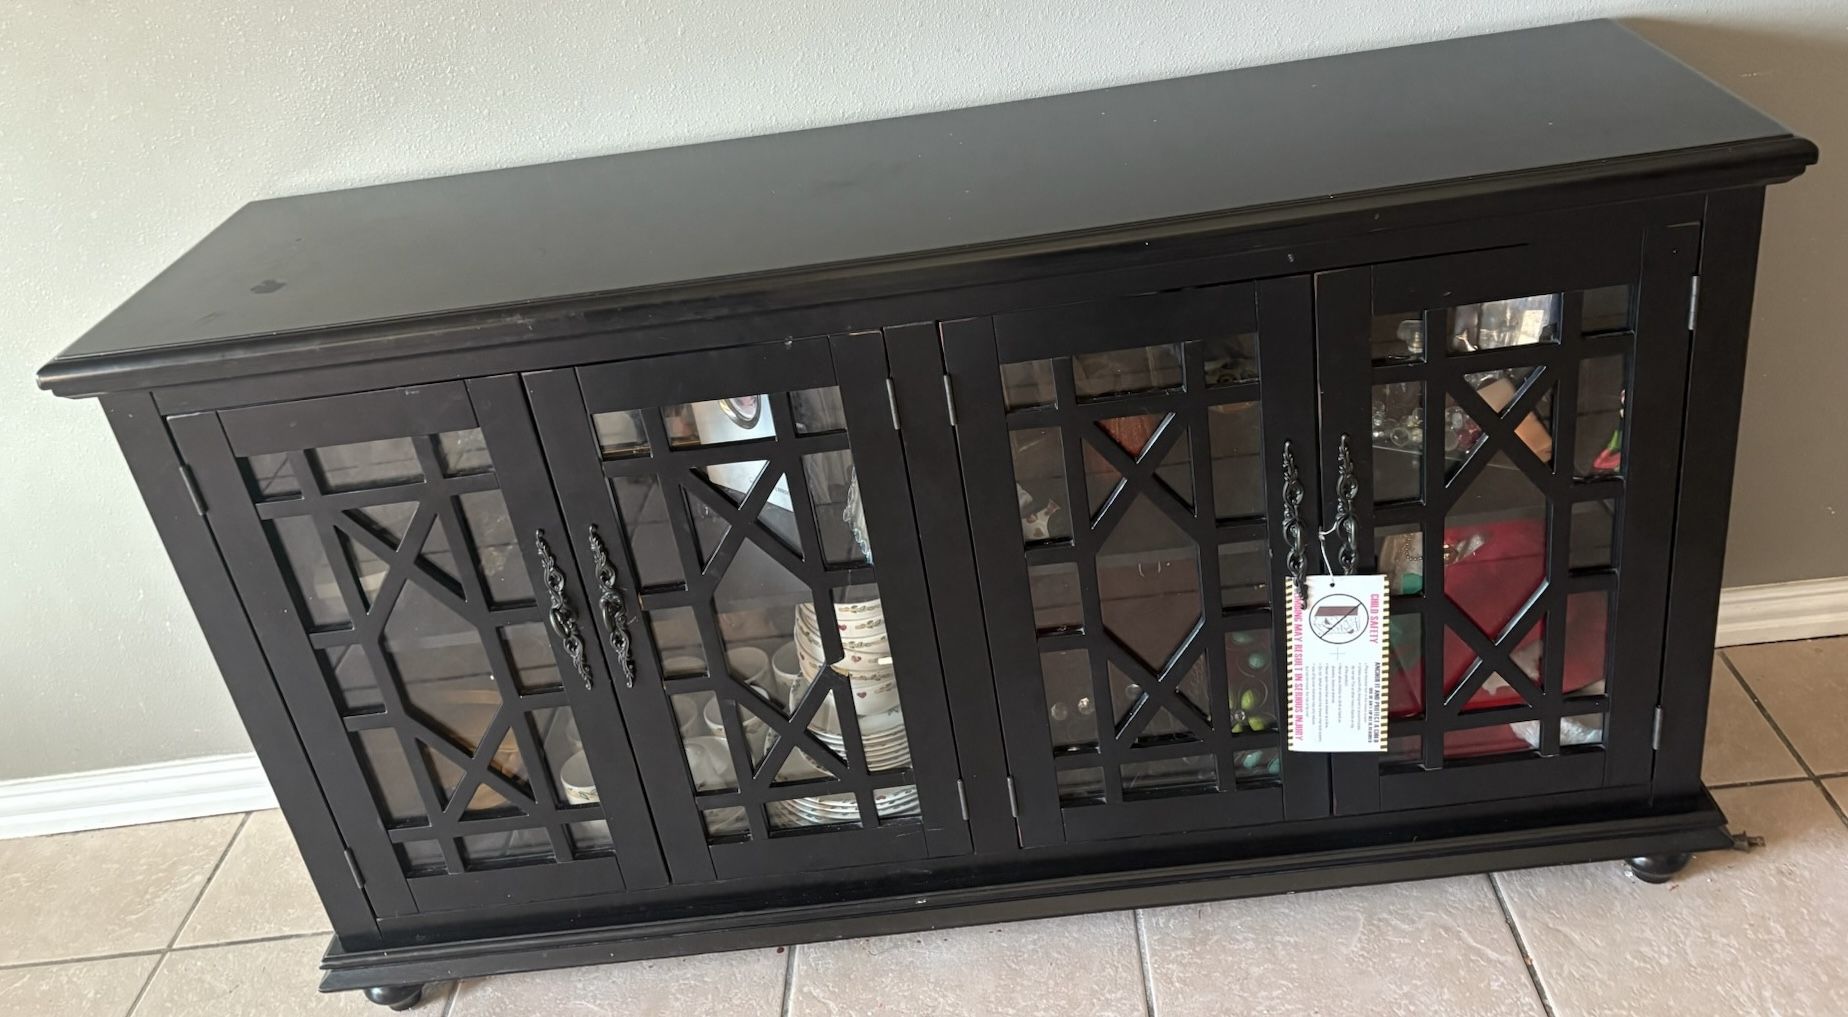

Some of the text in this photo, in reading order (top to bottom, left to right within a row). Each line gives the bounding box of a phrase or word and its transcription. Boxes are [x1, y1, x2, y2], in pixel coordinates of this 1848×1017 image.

[1370, 594, 1379, 644] CHILD SAFETY
[1294, 624, 1303, 642] MAY
[1294, 644, 1303, 671] RESULT
[1295, 673, 1303, 681] IN
[1295, 683, 1303, 713] SERIOUS
[1295, 715, 1304, 741] INJURY
